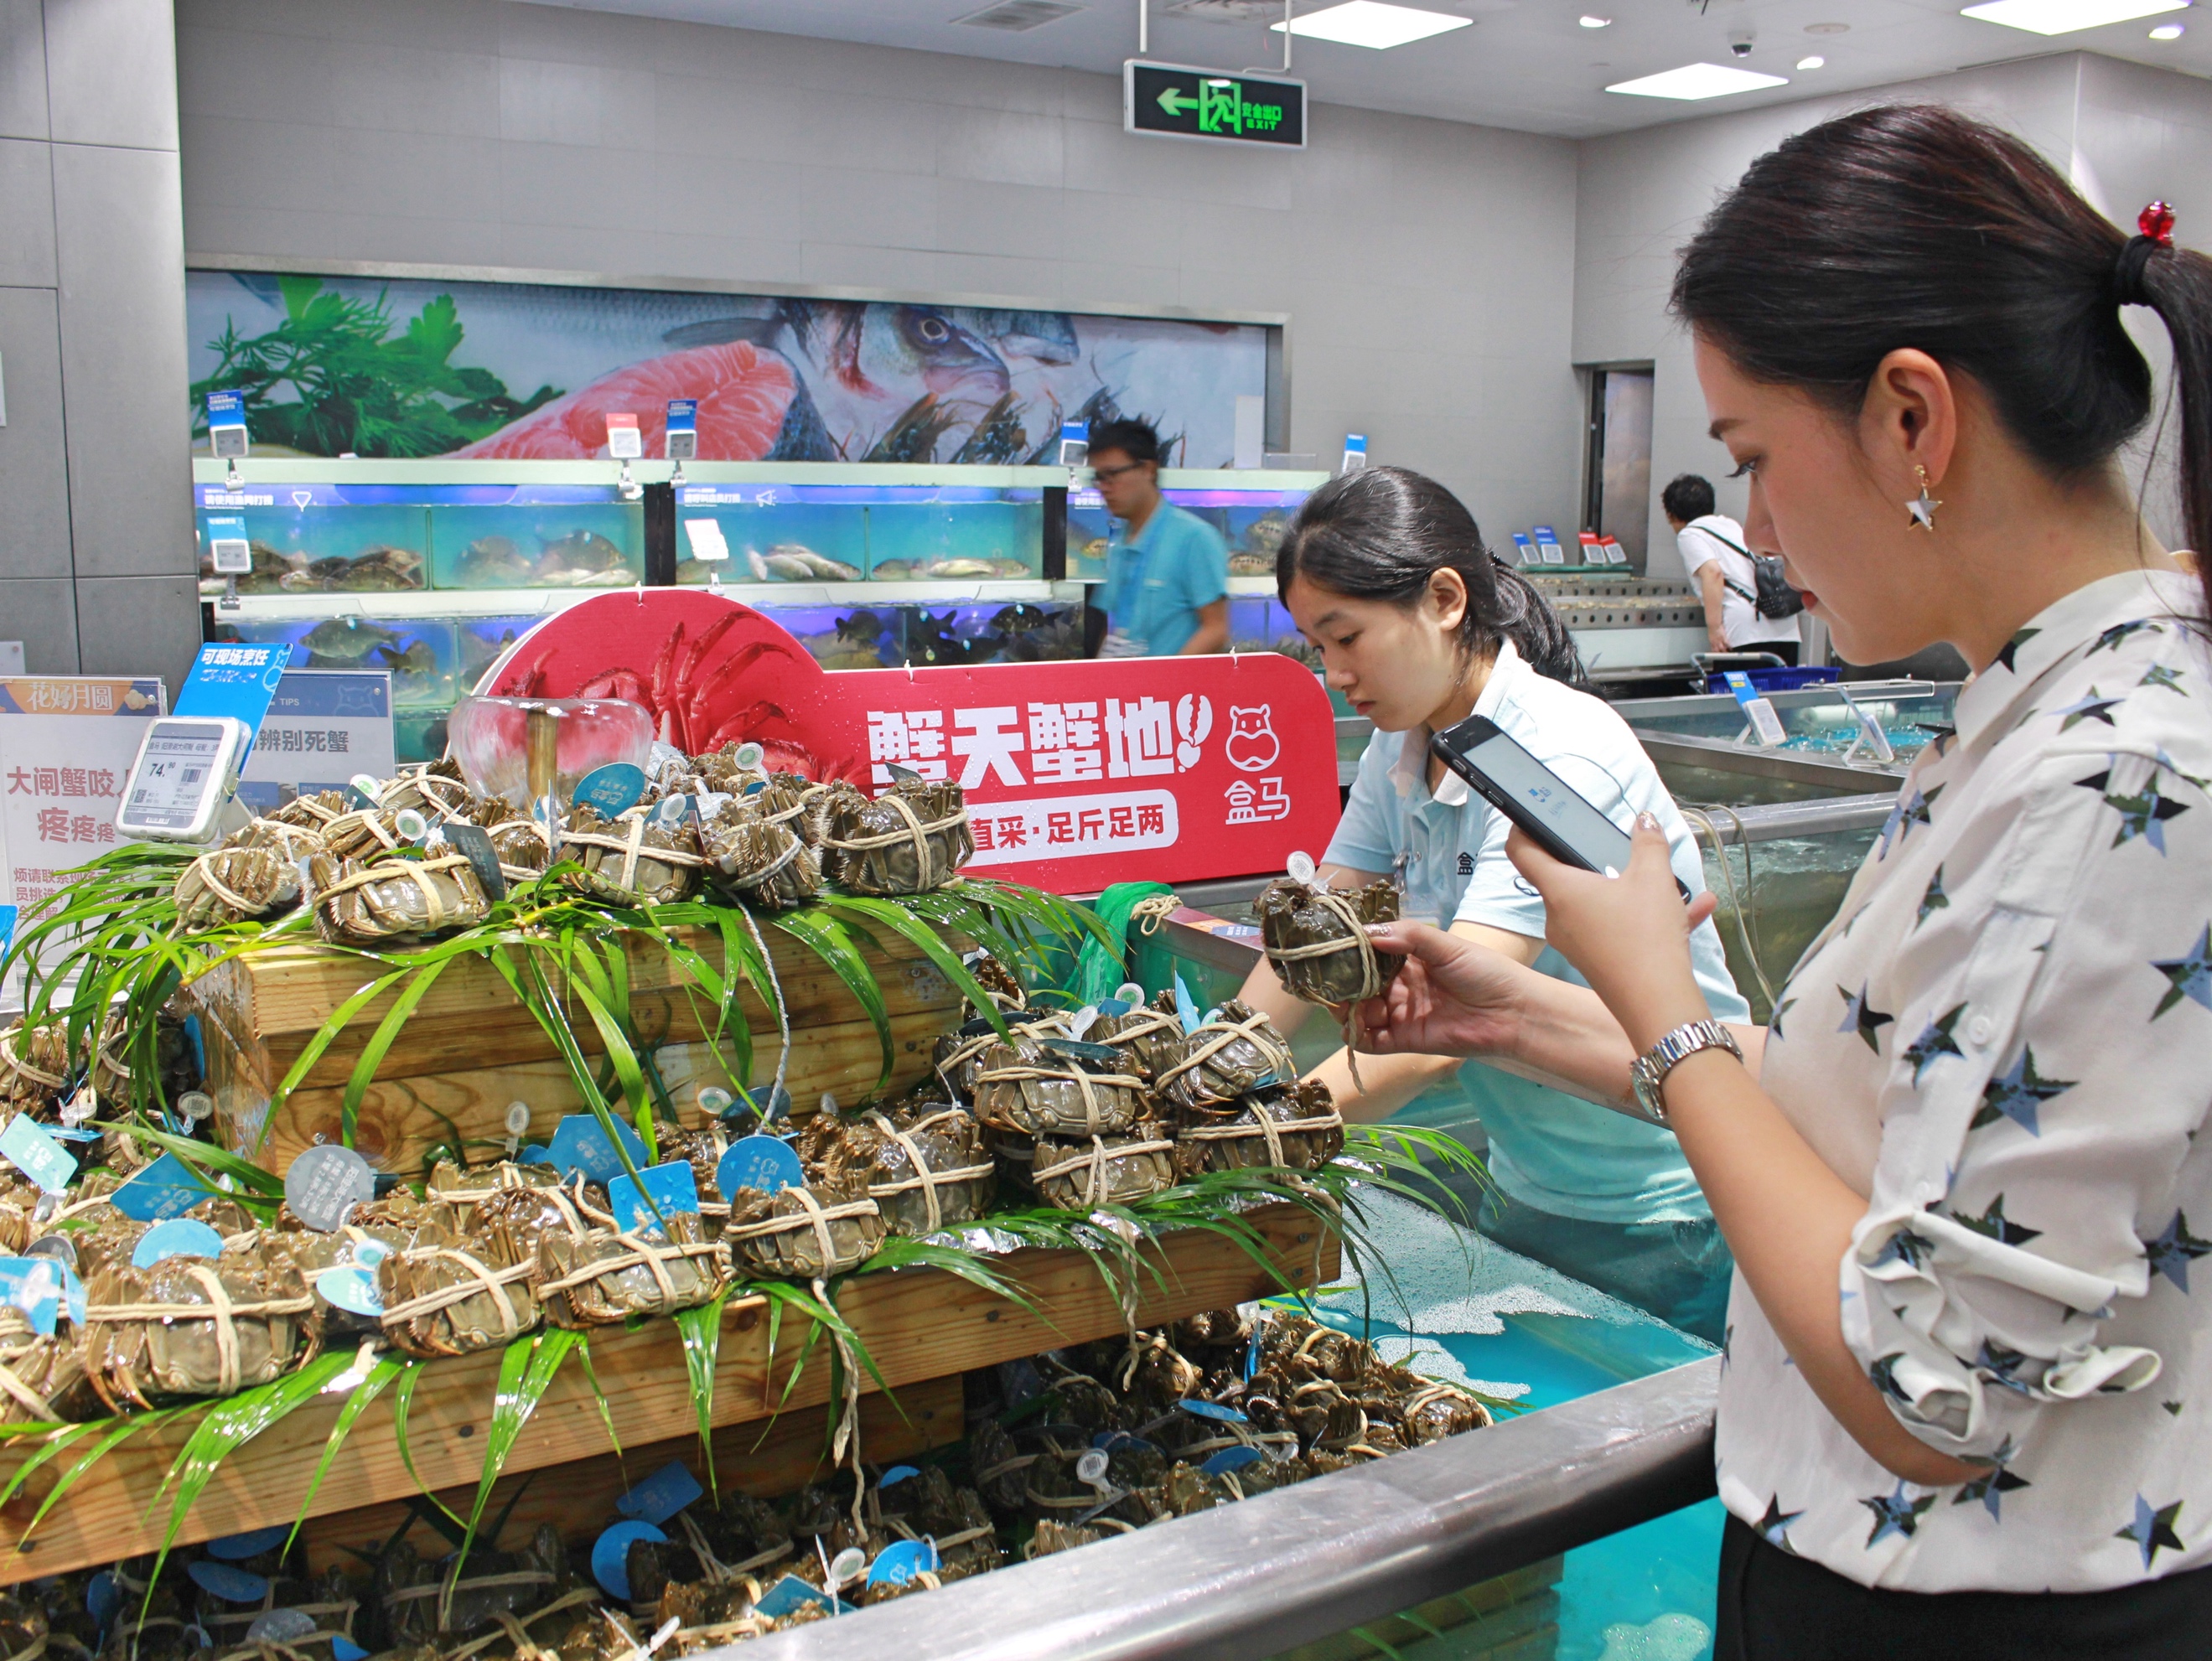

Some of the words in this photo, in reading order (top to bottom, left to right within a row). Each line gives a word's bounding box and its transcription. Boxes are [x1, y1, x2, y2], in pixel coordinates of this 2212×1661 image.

[1242, 101, 1282, 122] 安全出口
[1246, 118, 1277, 131] EXIT
[201, 649, 270, 665] 可现场烹饪
[27, 681, 113, 711] 花好月圆
[279, 698, 300, 706] TIPS
[1224, 776, 1291, 825] 盒马
[37, 807, 116, 844] 疼疼疼
[1457, 851, 1478, 875] 盒
